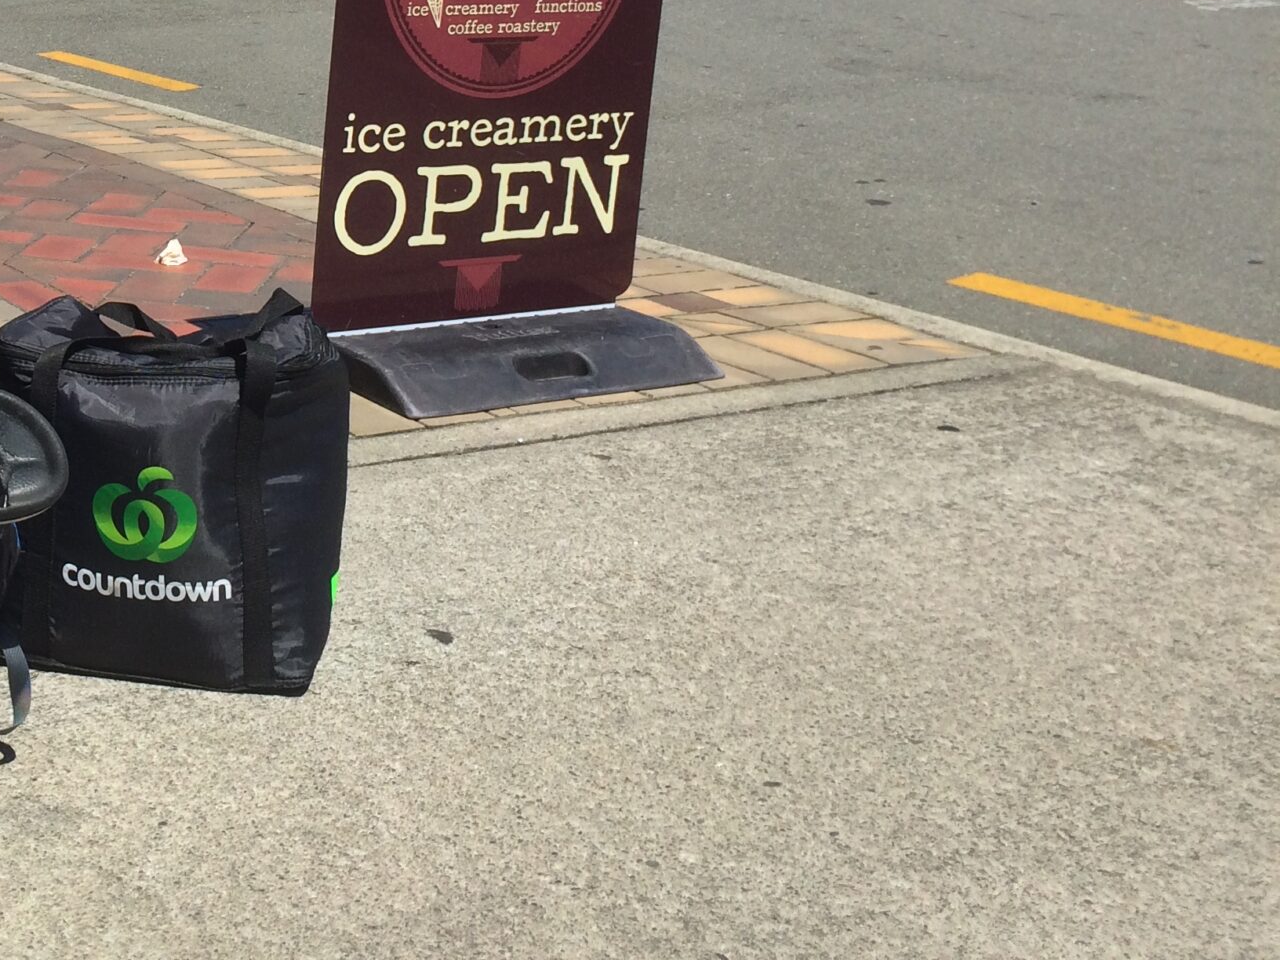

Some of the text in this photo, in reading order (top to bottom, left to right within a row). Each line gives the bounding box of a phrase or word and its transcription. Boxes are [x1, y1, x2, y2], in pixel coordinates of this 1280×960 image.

[407, 1, 430, 17] ice
[445, 2, 520, 18] creamery
[447, 19, 561, 36] coffee roastery
[343, 111, 634, 153] ice creamery
[334, 154, 630, 256] OPEN
[62, 563, 232, 602] countdown
